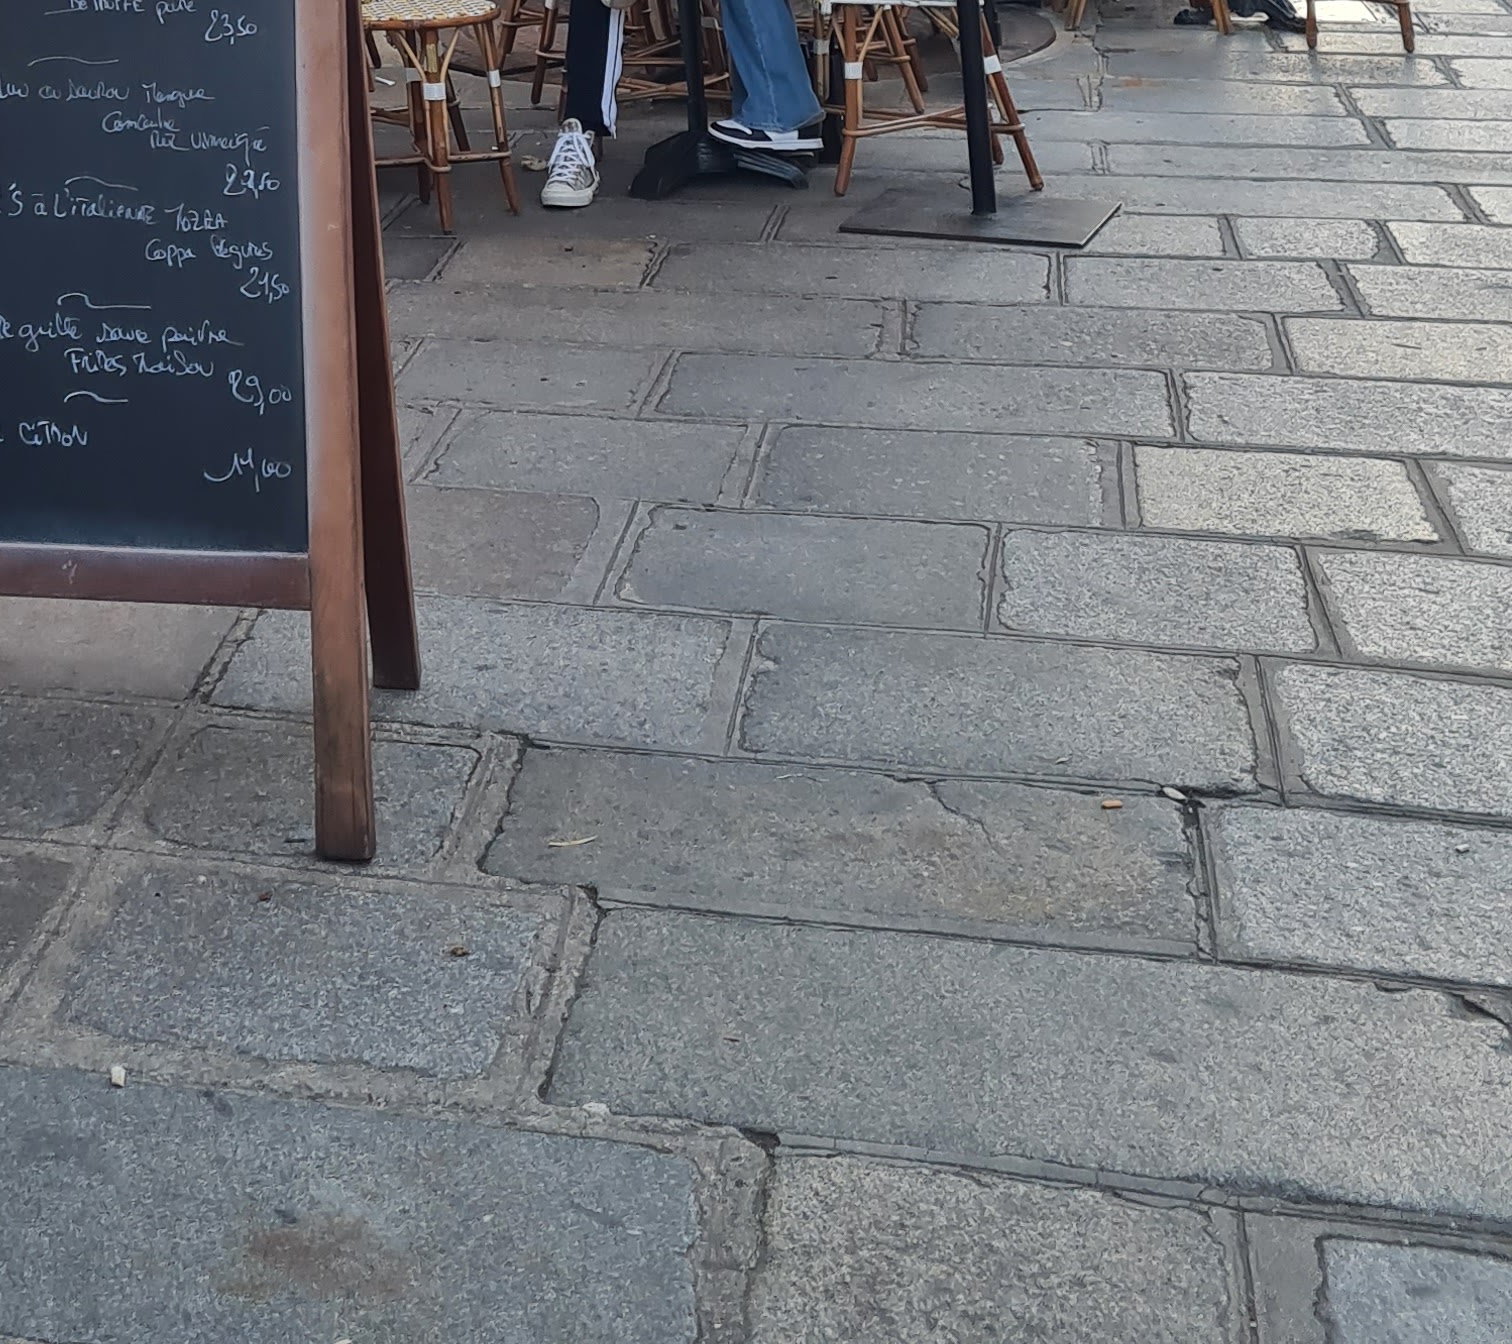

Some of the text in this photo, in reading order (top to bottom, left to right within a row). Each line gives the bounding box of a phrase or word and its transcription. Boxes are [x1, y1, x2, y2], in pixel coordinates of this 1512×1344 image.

[204, 9, 258, 46] 23,50
[239, 266, 290, 304] 21,50
[228, 368, 293, 416] 29,00
